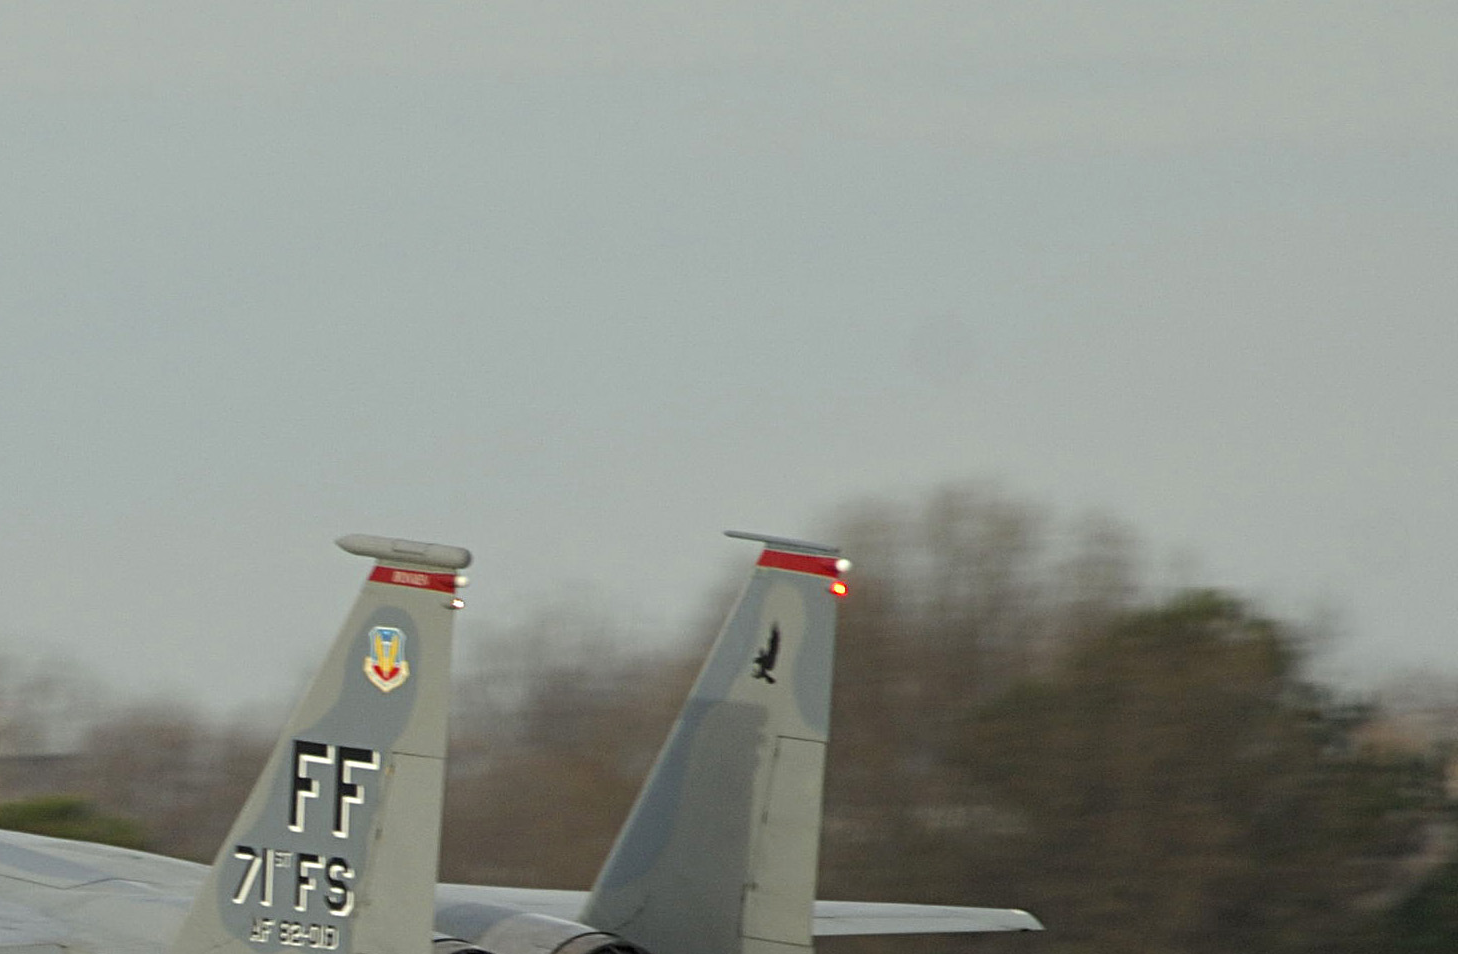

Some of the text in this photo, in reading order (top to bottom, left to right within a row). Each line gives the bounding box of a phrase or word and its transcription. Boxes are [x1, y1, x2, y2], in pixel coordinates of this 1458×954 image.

[288, 739, 382, 839] FF
[294, 853, 356, 917] FS
[249, 917, 276, 943] AF
